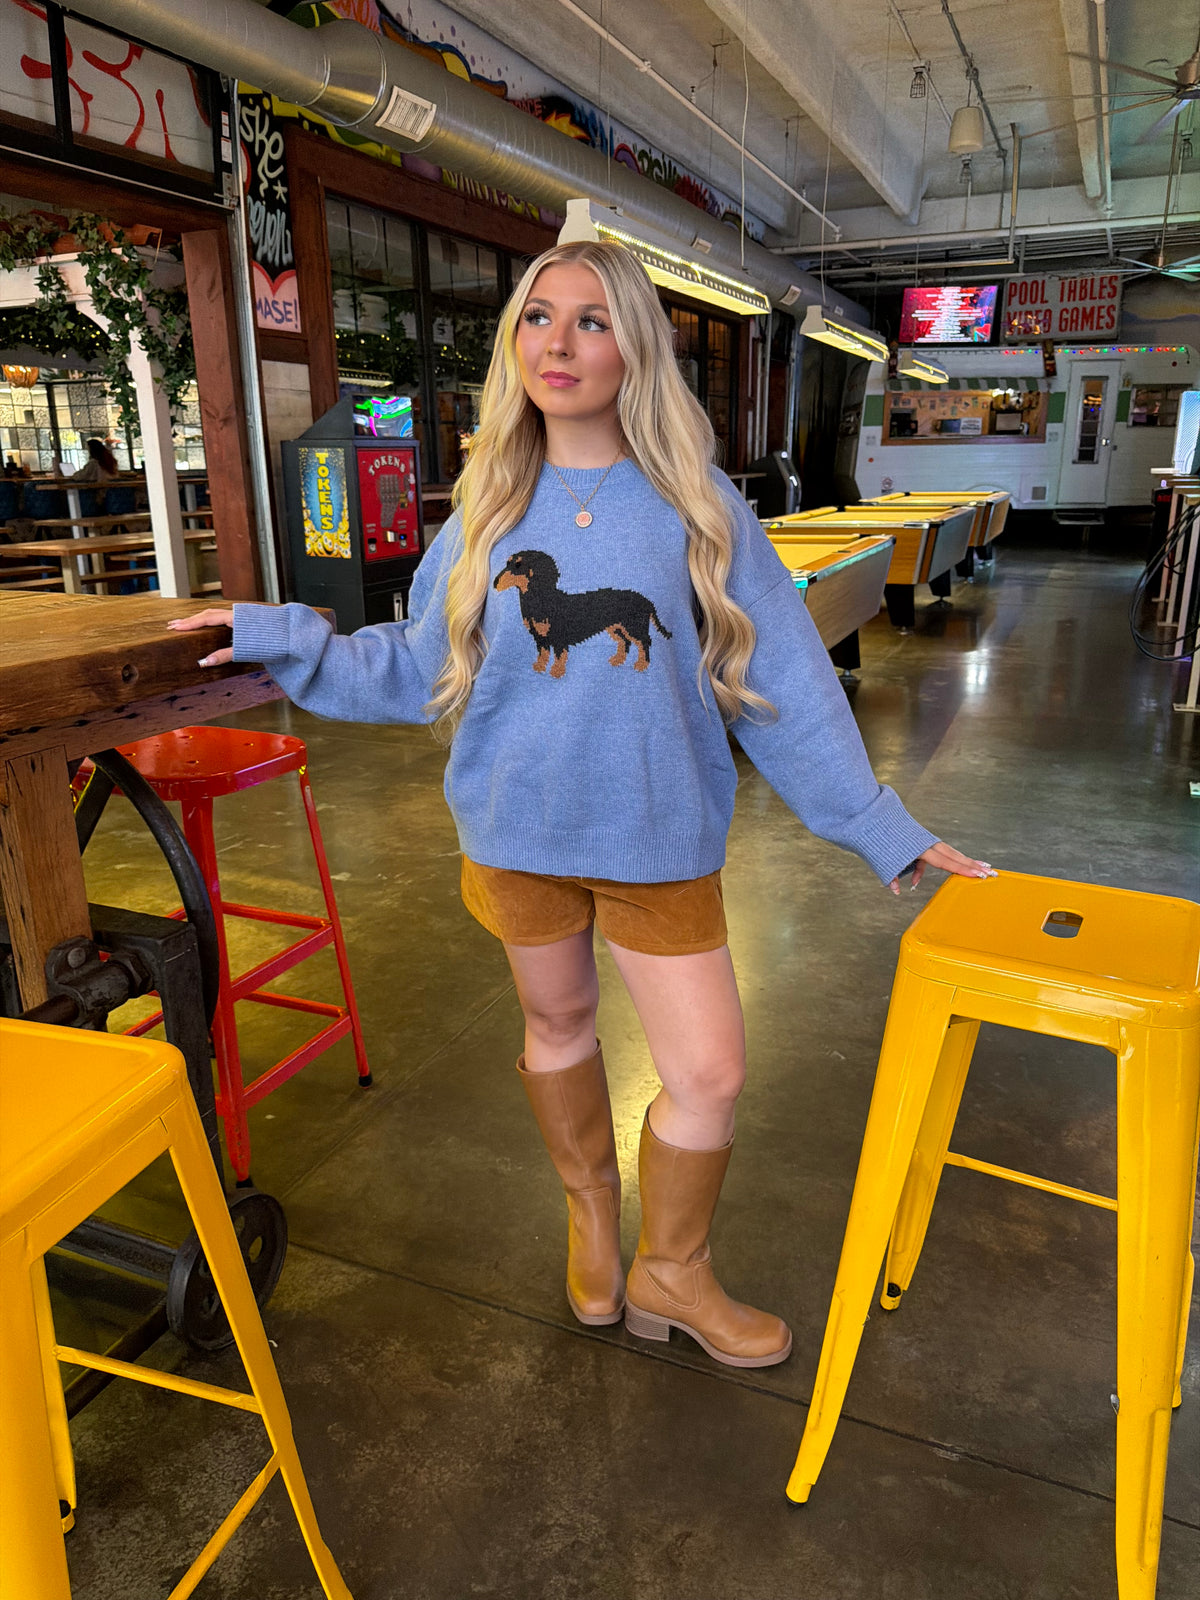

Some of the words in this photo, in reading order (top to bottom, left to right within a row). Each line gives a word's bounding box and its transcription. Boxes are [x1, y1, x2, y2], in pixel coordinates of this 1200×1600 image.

[1008, 279, 1049, 307] POOL
[1059, 275, 1119, 303] TABLES
[1006, 308, 1053, 336] VIDEO
[1058, 304, 1117, 333] GAMES
[368, 455, 406, 477] TOKENS
[315, 452, 334, 530] TOKENS
